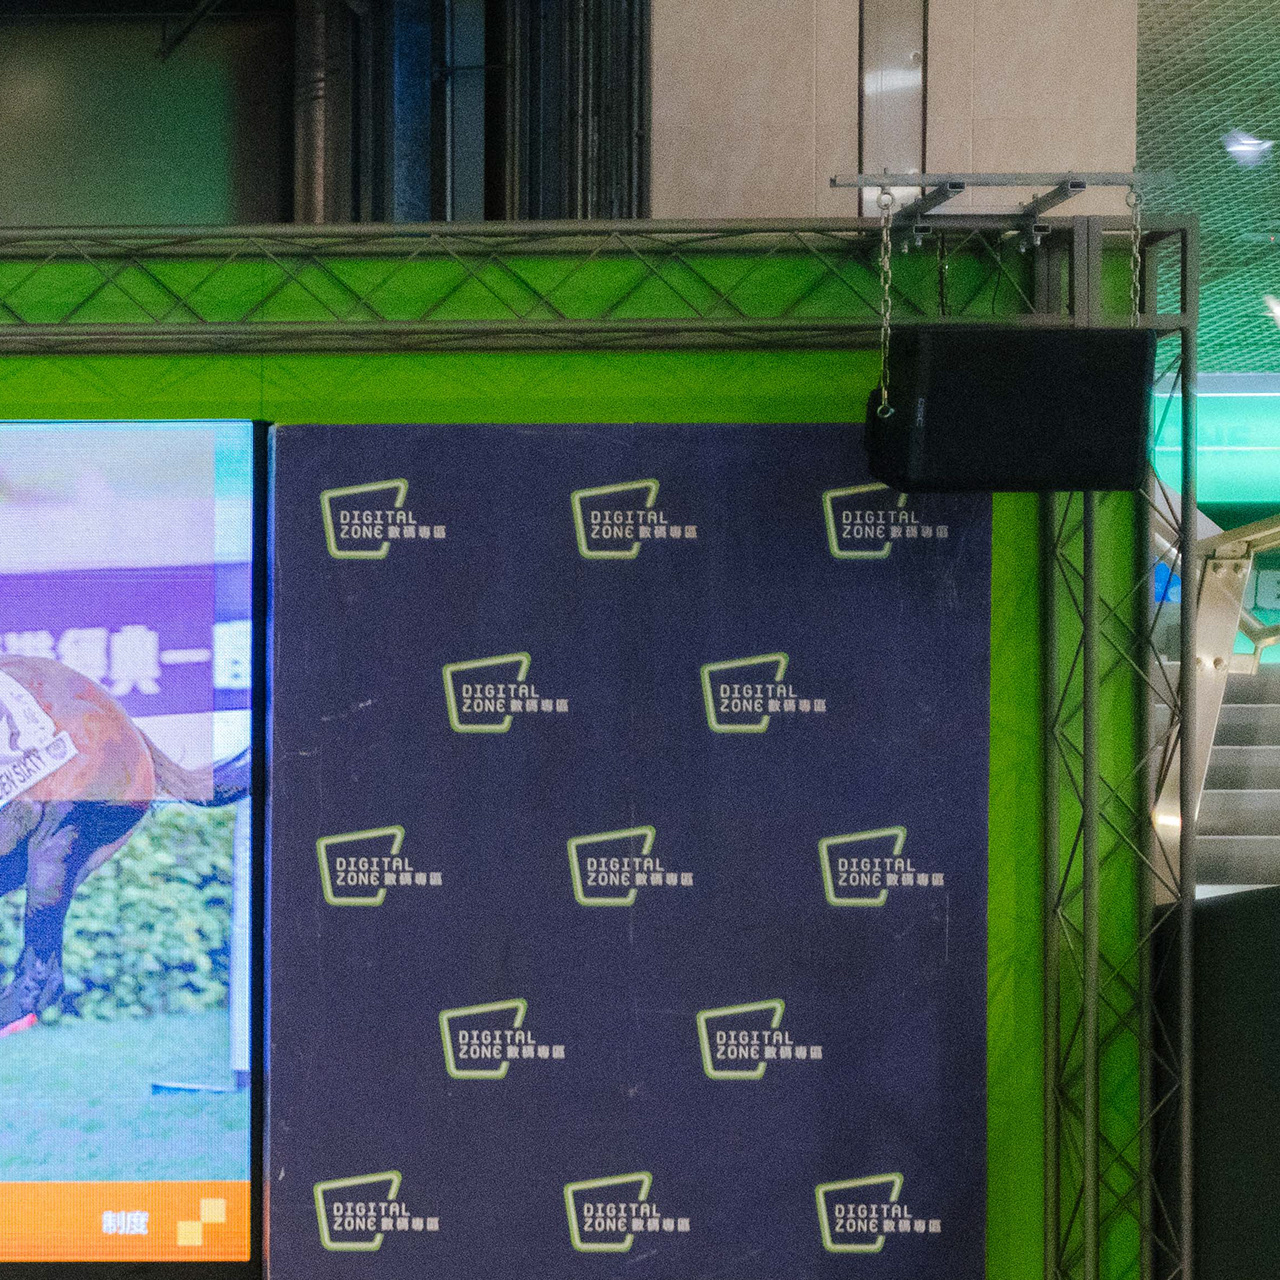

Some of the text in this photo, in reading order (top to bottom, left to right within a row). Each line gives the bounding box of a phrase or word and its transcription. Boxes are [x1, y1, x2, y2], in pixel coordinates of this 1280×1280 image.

[339, 510, 418, 524] DIGITAL
[590, 510, 669, 524] DIGITAL
[841, 510, 920, 524] DIGITAL
[339, 525, 385, 539] ZONE
[590, 525, 636, 539] ZONE
[841, 525, 887, 539] ZONE
[461, 684, 540, 698] DIGITAL
[719, 684, 798, 698] DIGITAL
[461, 699, 507, 713] ZONE
[719, 699, 765, 713] ZONE
[335, 857, 414, 871] DIGITAL
[586, 857, 665, 871] DIGITAL
[837, 858, 916, 872] DIGITAL
[335, 872, 381, 886] ZONE
[586, 872, 632, 886] ZONE
[837, 873, 883, 887] ZONE
[458, 1030, 537, 1044] DIGITAL
[715, 1030, 794, 1044] DIGITAL
[458, 1045, 504, 1059] ZONE
[715, 1045, 761, 1059] ZONE
[332, 1202, 411, 1216] DIGITAL
[583, 1203, 662, 1217] DIGITAL
[834, 1204, 913, 1218] DIGITAL
[332, 1217, 378, 1231] ZONE
[583, 1218, 629, 1232] ZONE
[834, 1219, 880, 1233] ZONE
